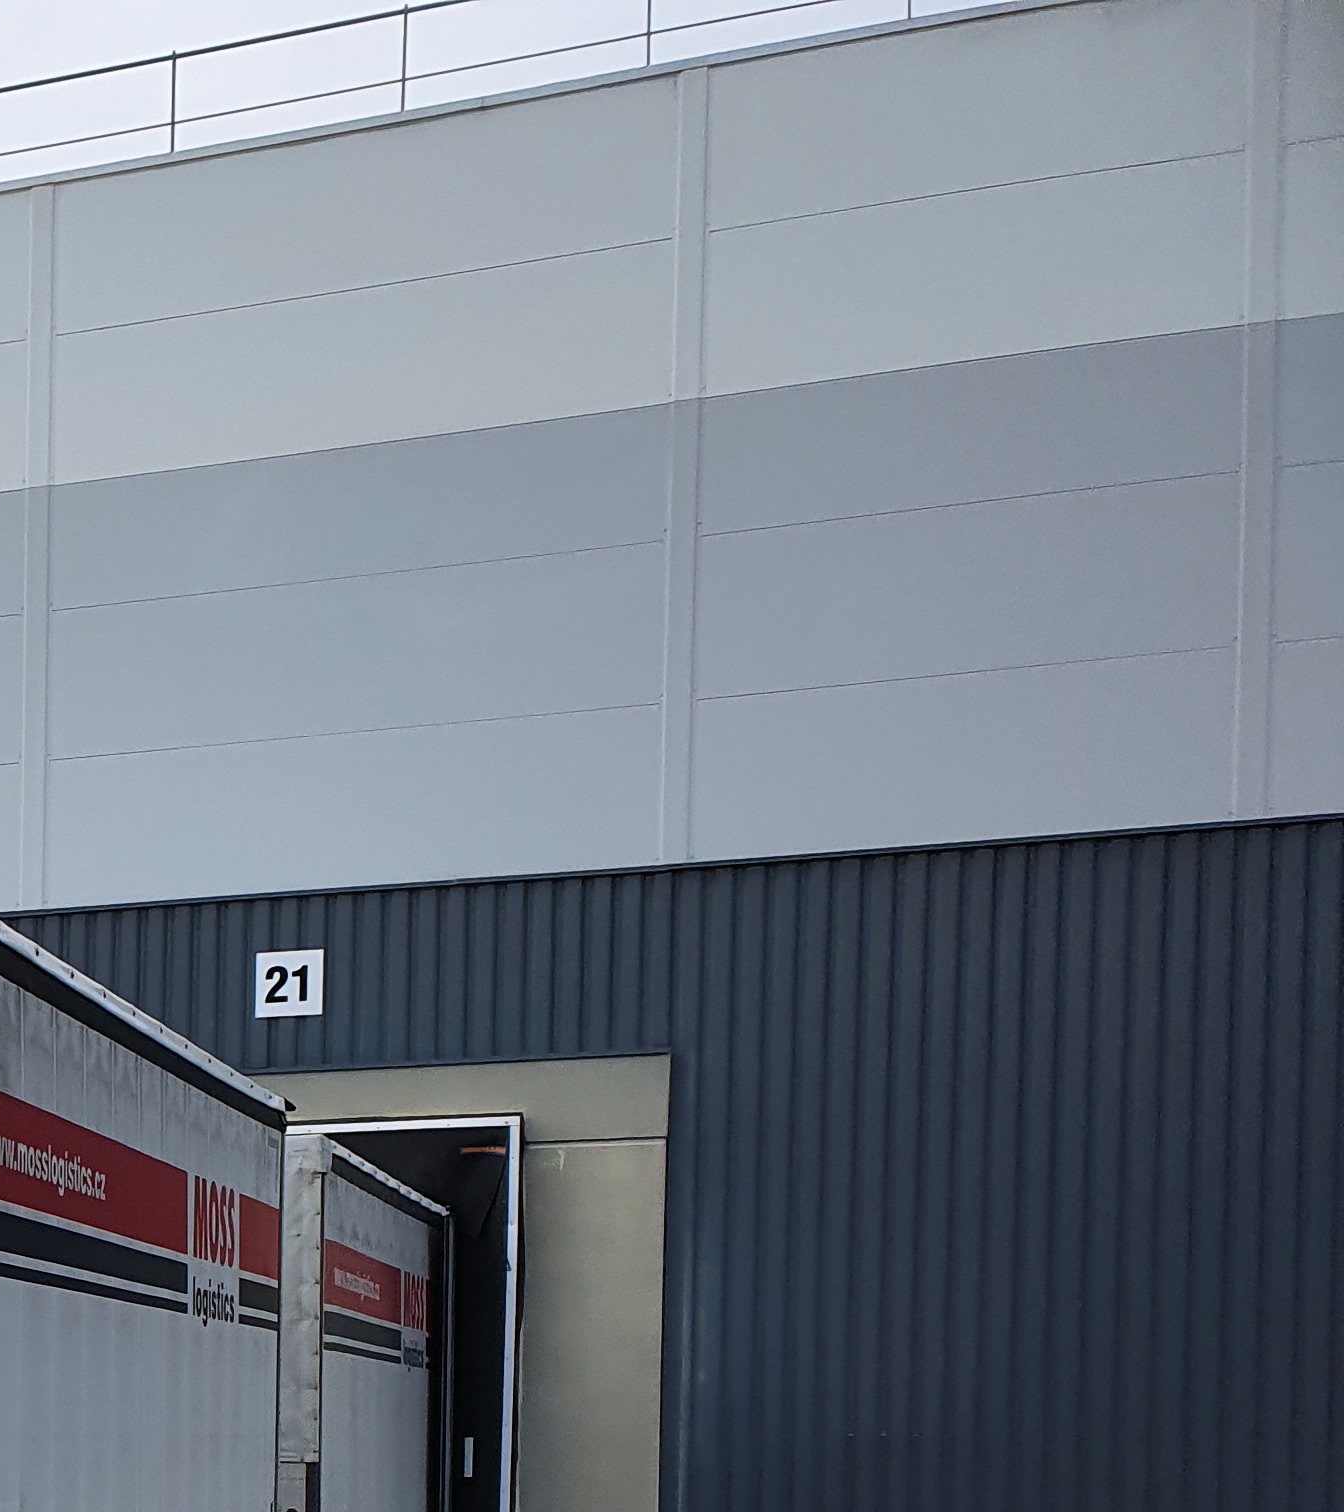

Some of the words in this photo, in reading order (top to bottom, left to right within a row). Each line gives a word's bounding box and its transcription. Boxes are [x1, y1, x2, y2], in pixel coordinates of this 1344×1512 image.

[265, 965, 308, 1003] 21
[192, 1174, 236, 1268] MOSS
[192, 1275, 235, 1327] logistics
